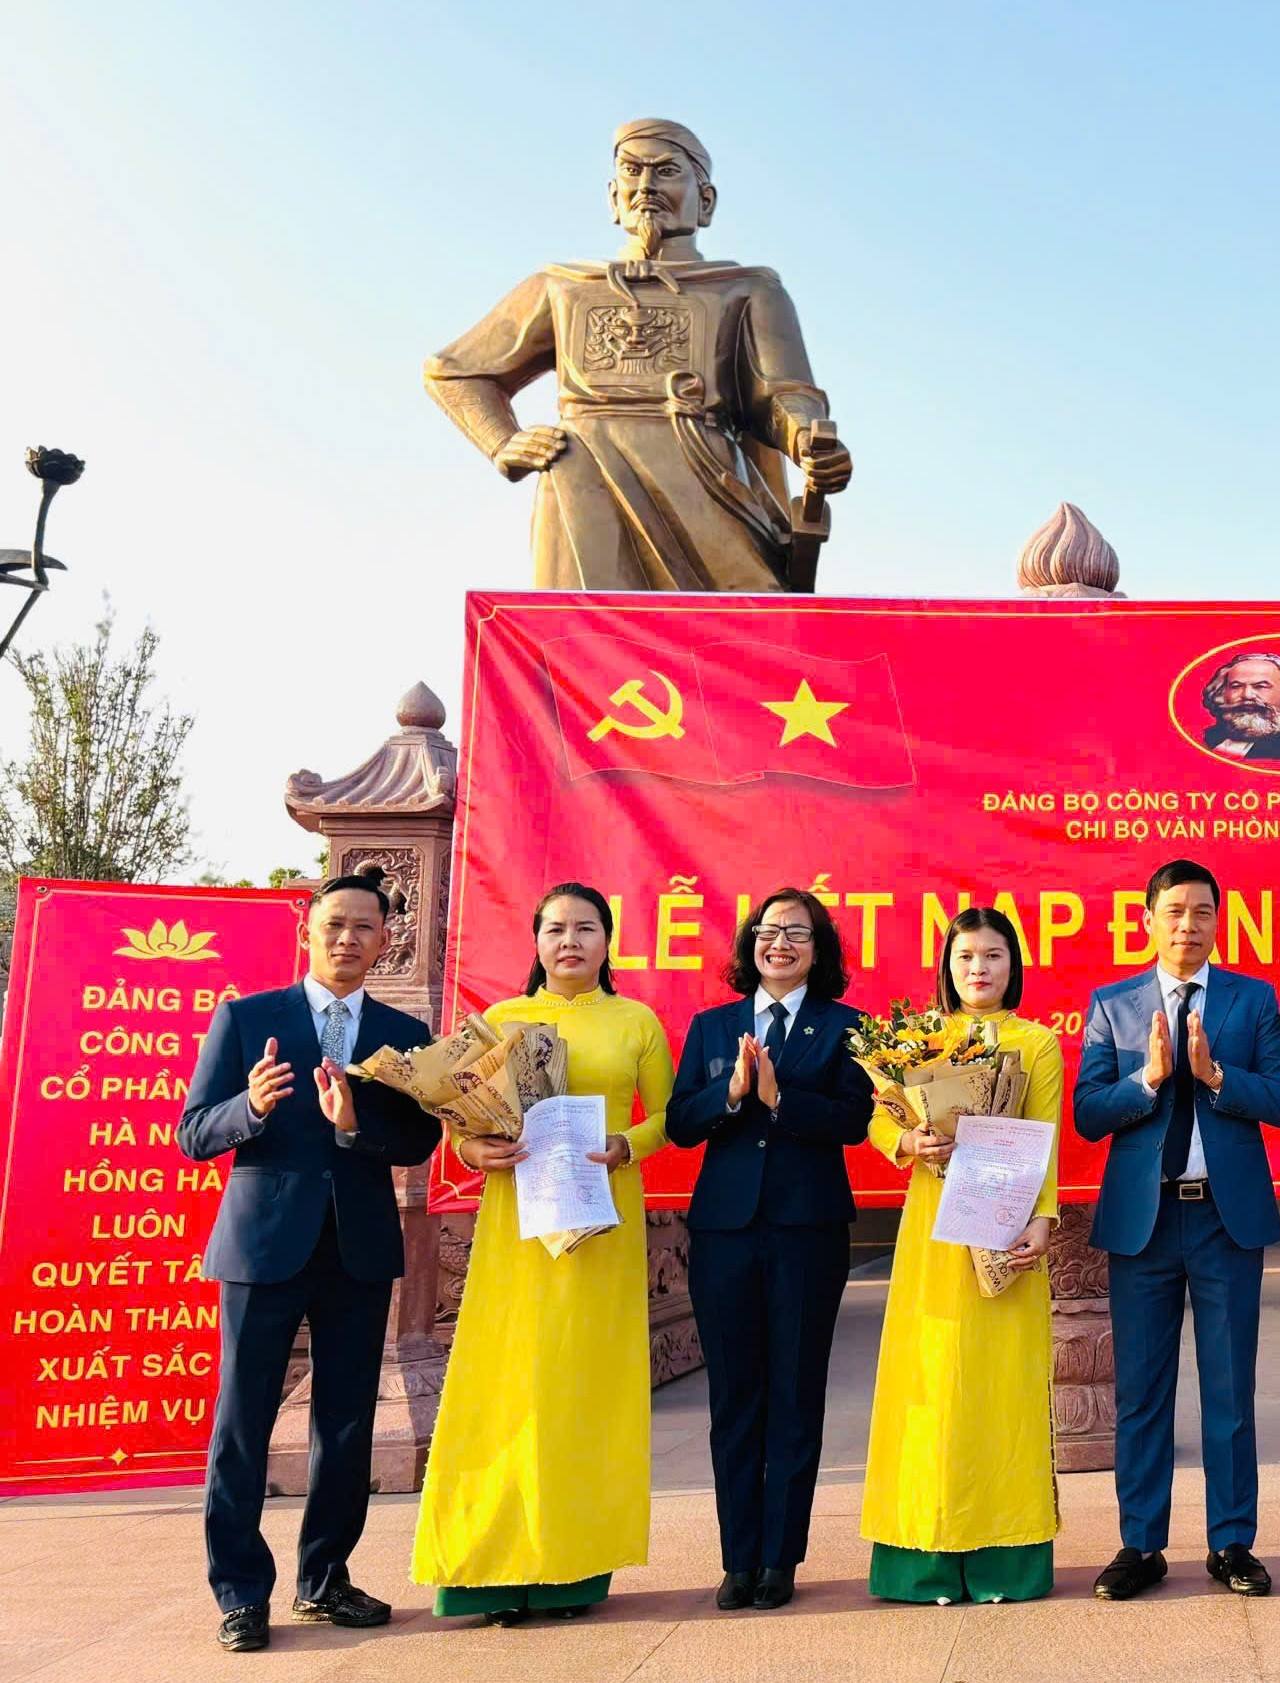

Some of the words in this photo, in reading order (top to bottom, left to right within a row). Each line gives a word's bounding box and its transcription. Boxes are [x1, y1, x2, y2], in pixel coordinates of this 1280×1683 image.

[982, 790, 1055, 811] ĐẢNG
[1063, 791, 1099, 814] BỘ
[1107, 789, 1179, 811] CÔNG
[1187, 792, 1216, 810] TY
[1065, 820, 1106, 840] CHI
[1114, 818, 1149, 843] BỘ
[1157, 816, 1205, 838] VĂN
[608, 874, 704, 970] LỄ
[82, 978, 181, 1012] ĐẢNG
[79, 1026, 180, 1056] CÔNG
[40, 1064, 91, 1100] CỔ
[89, 1117, 137, 1146] HÀ
[63, 1158, 165, 1193] HỒNG
[176, 1161, 223, 1192] HÀ
[91, 1207, 186, 1239] LUÔN
[31, 1251, 152, 1288] QUYẾT
[162, 1253, 213, 1283] TÂ
[13, 1303, 113, 1334] HOÀN
[125, 1301, 219, 1332] THÀN
[36, 1346, 132, 1382] XUẤT
[141, 1342, 213, 1377] SẮC
[35, 1395, 149, 1430] NHIỆM
[160, 1398, 206, 1426] VỤ
